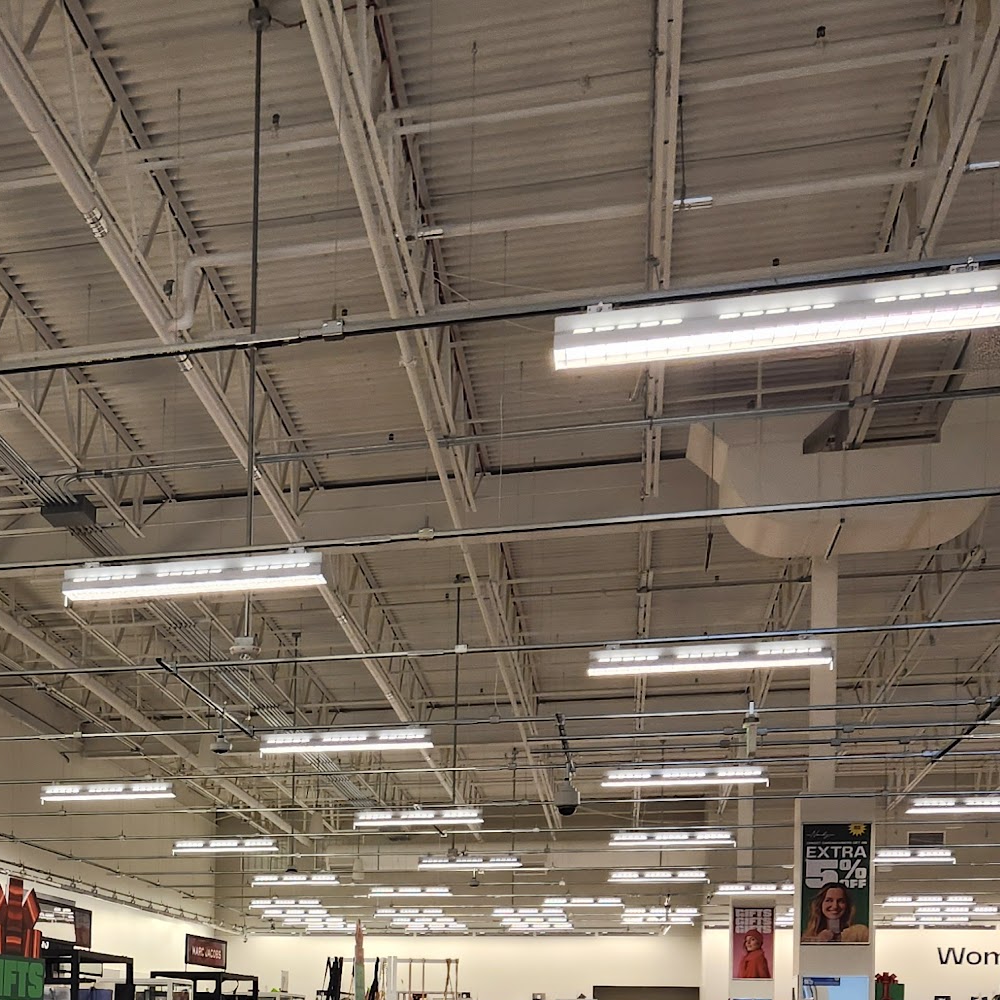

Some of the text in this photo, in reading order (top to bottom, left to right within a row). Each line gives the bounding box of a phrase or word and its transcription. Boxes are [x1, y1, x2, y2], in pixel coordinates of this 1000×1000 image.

[806, 846, 868, 858] EXTRA
[805, 859, 868, 888] 5%
[839, 880, 867, 888] OFF
[735, 909, 772, 918] GIFTS
[735, 918, 772, 926] GIFTS
[204, 948, 221, 959] JACOBS
